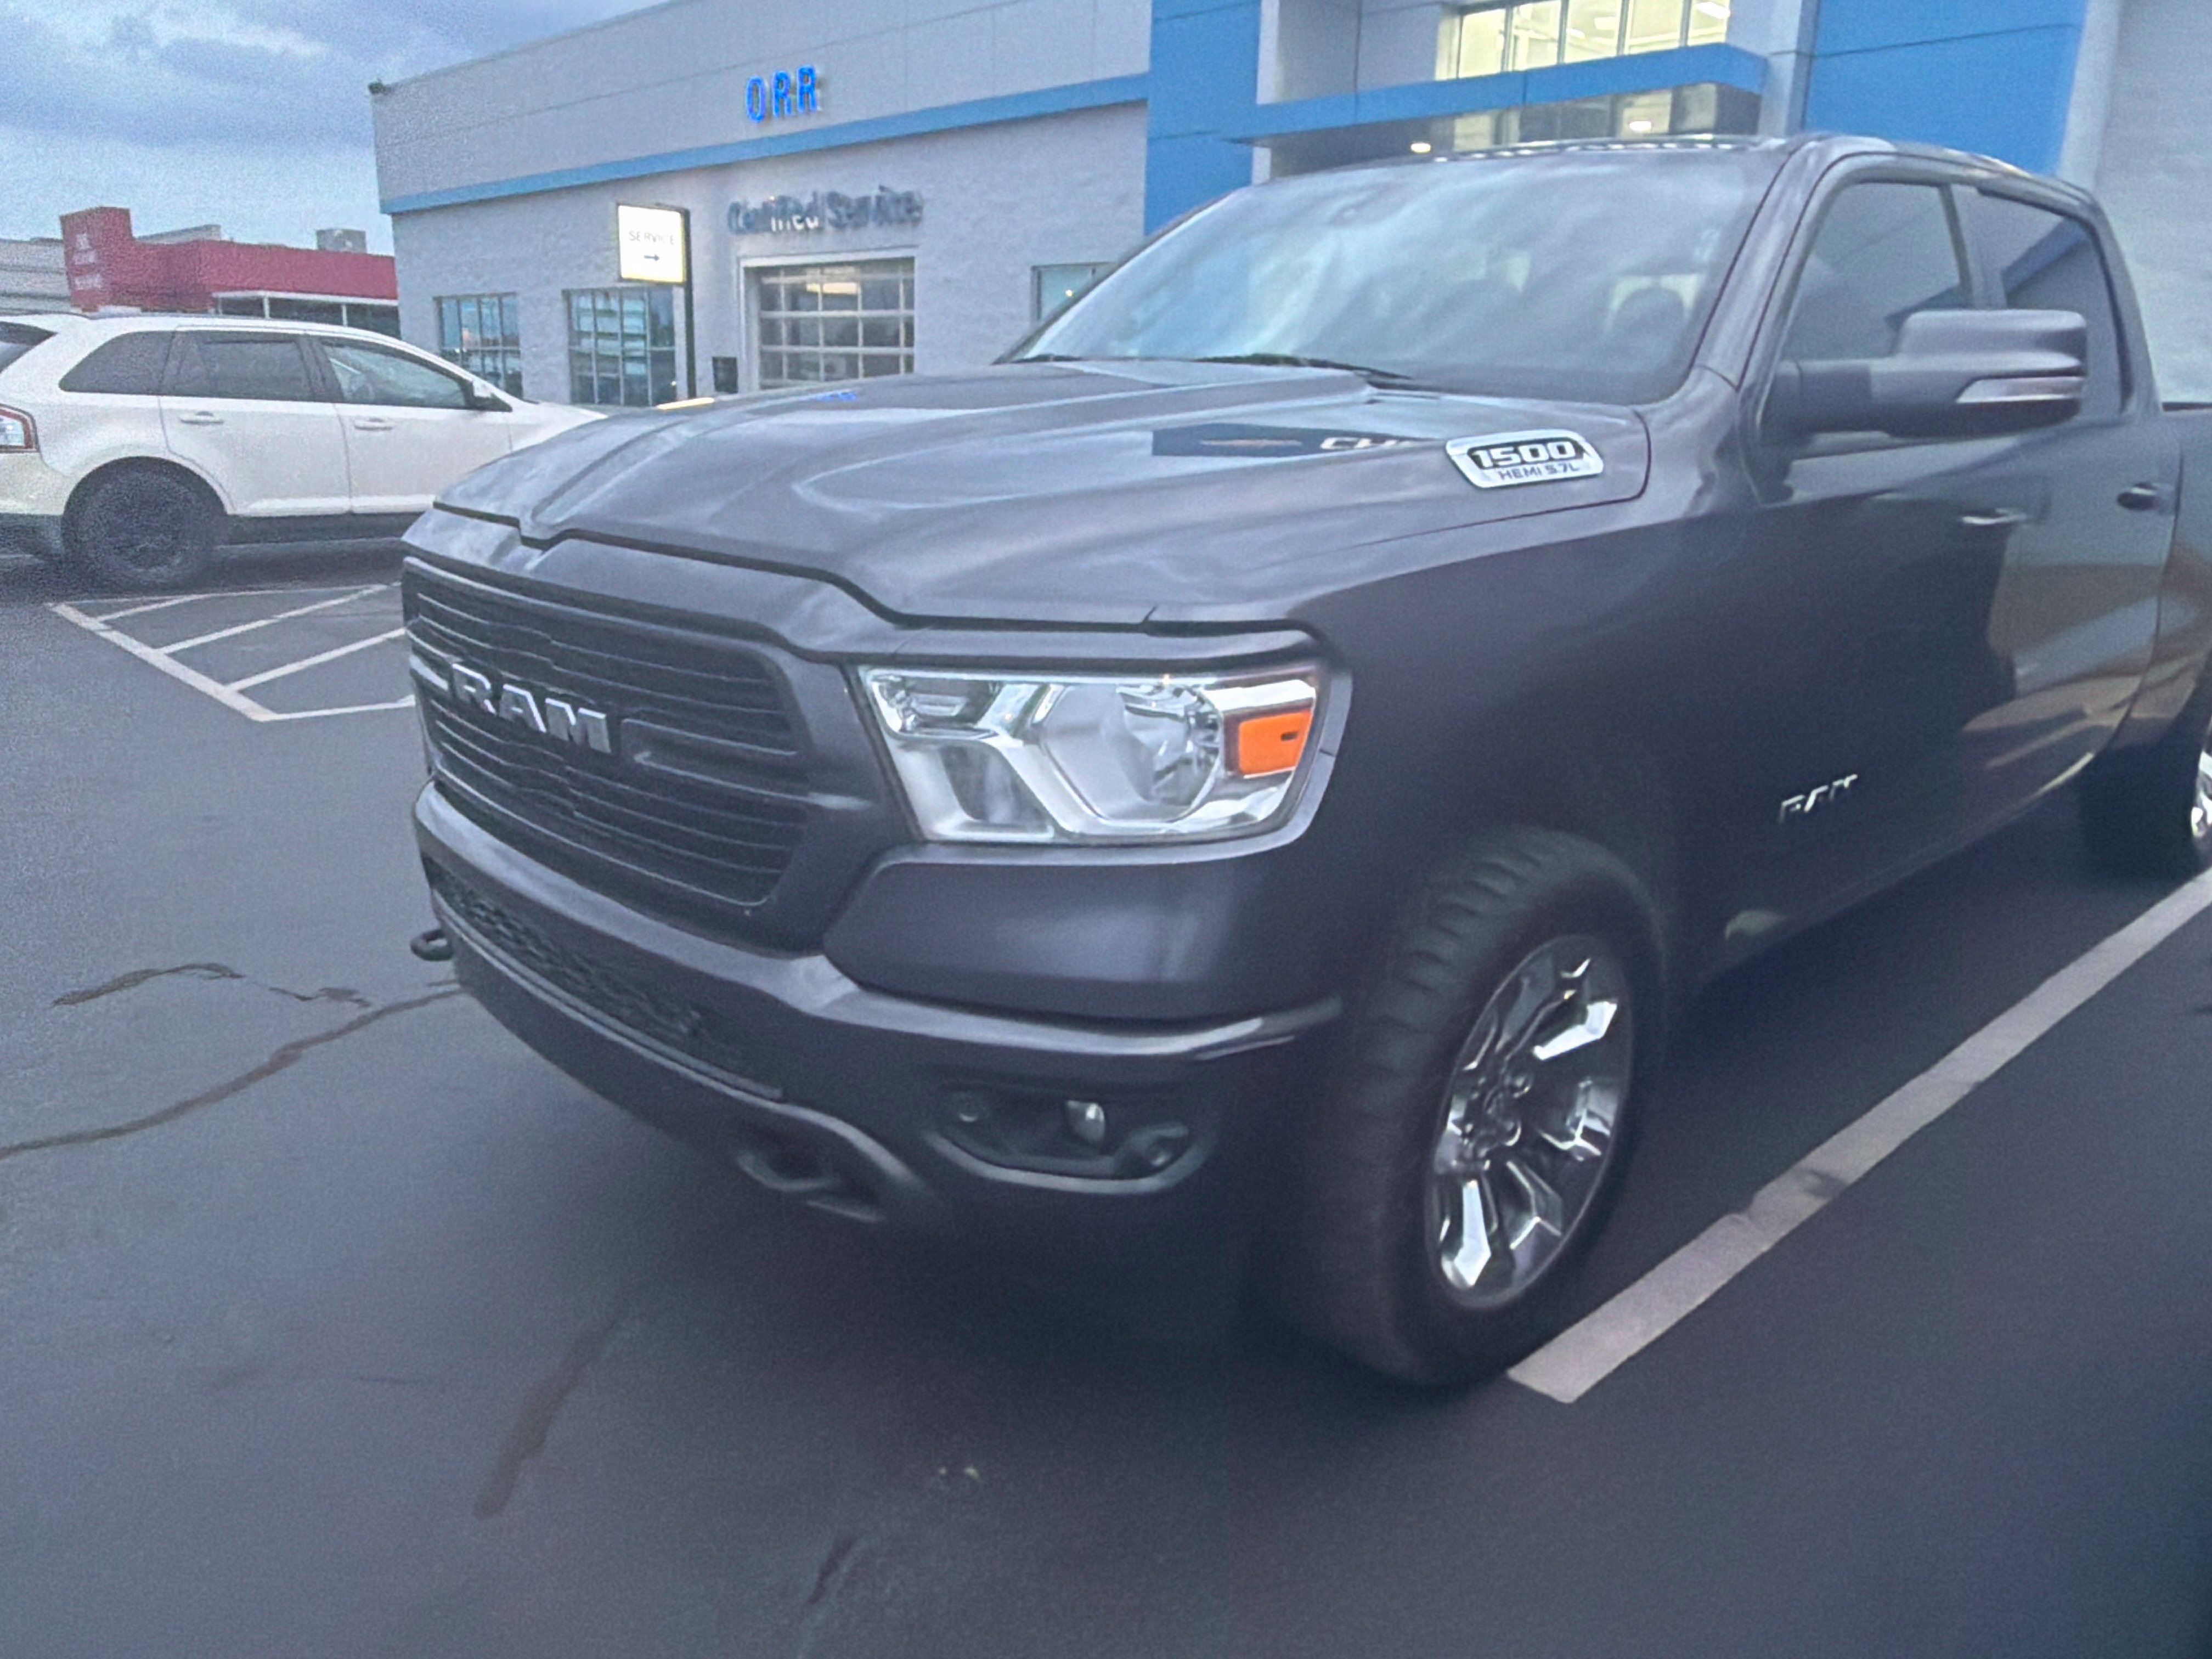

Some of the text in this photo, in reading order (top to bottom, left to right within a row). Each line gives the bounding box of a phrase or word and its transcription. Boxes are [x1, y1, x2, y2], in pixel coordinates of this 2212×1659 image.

[746, 65, 816, 123] ORR
[1471, 441, 1576, 469] 1500
[1498, 461, 1581, 480] HEMI 5.7L
[452, 662, 612, 754] RAM
